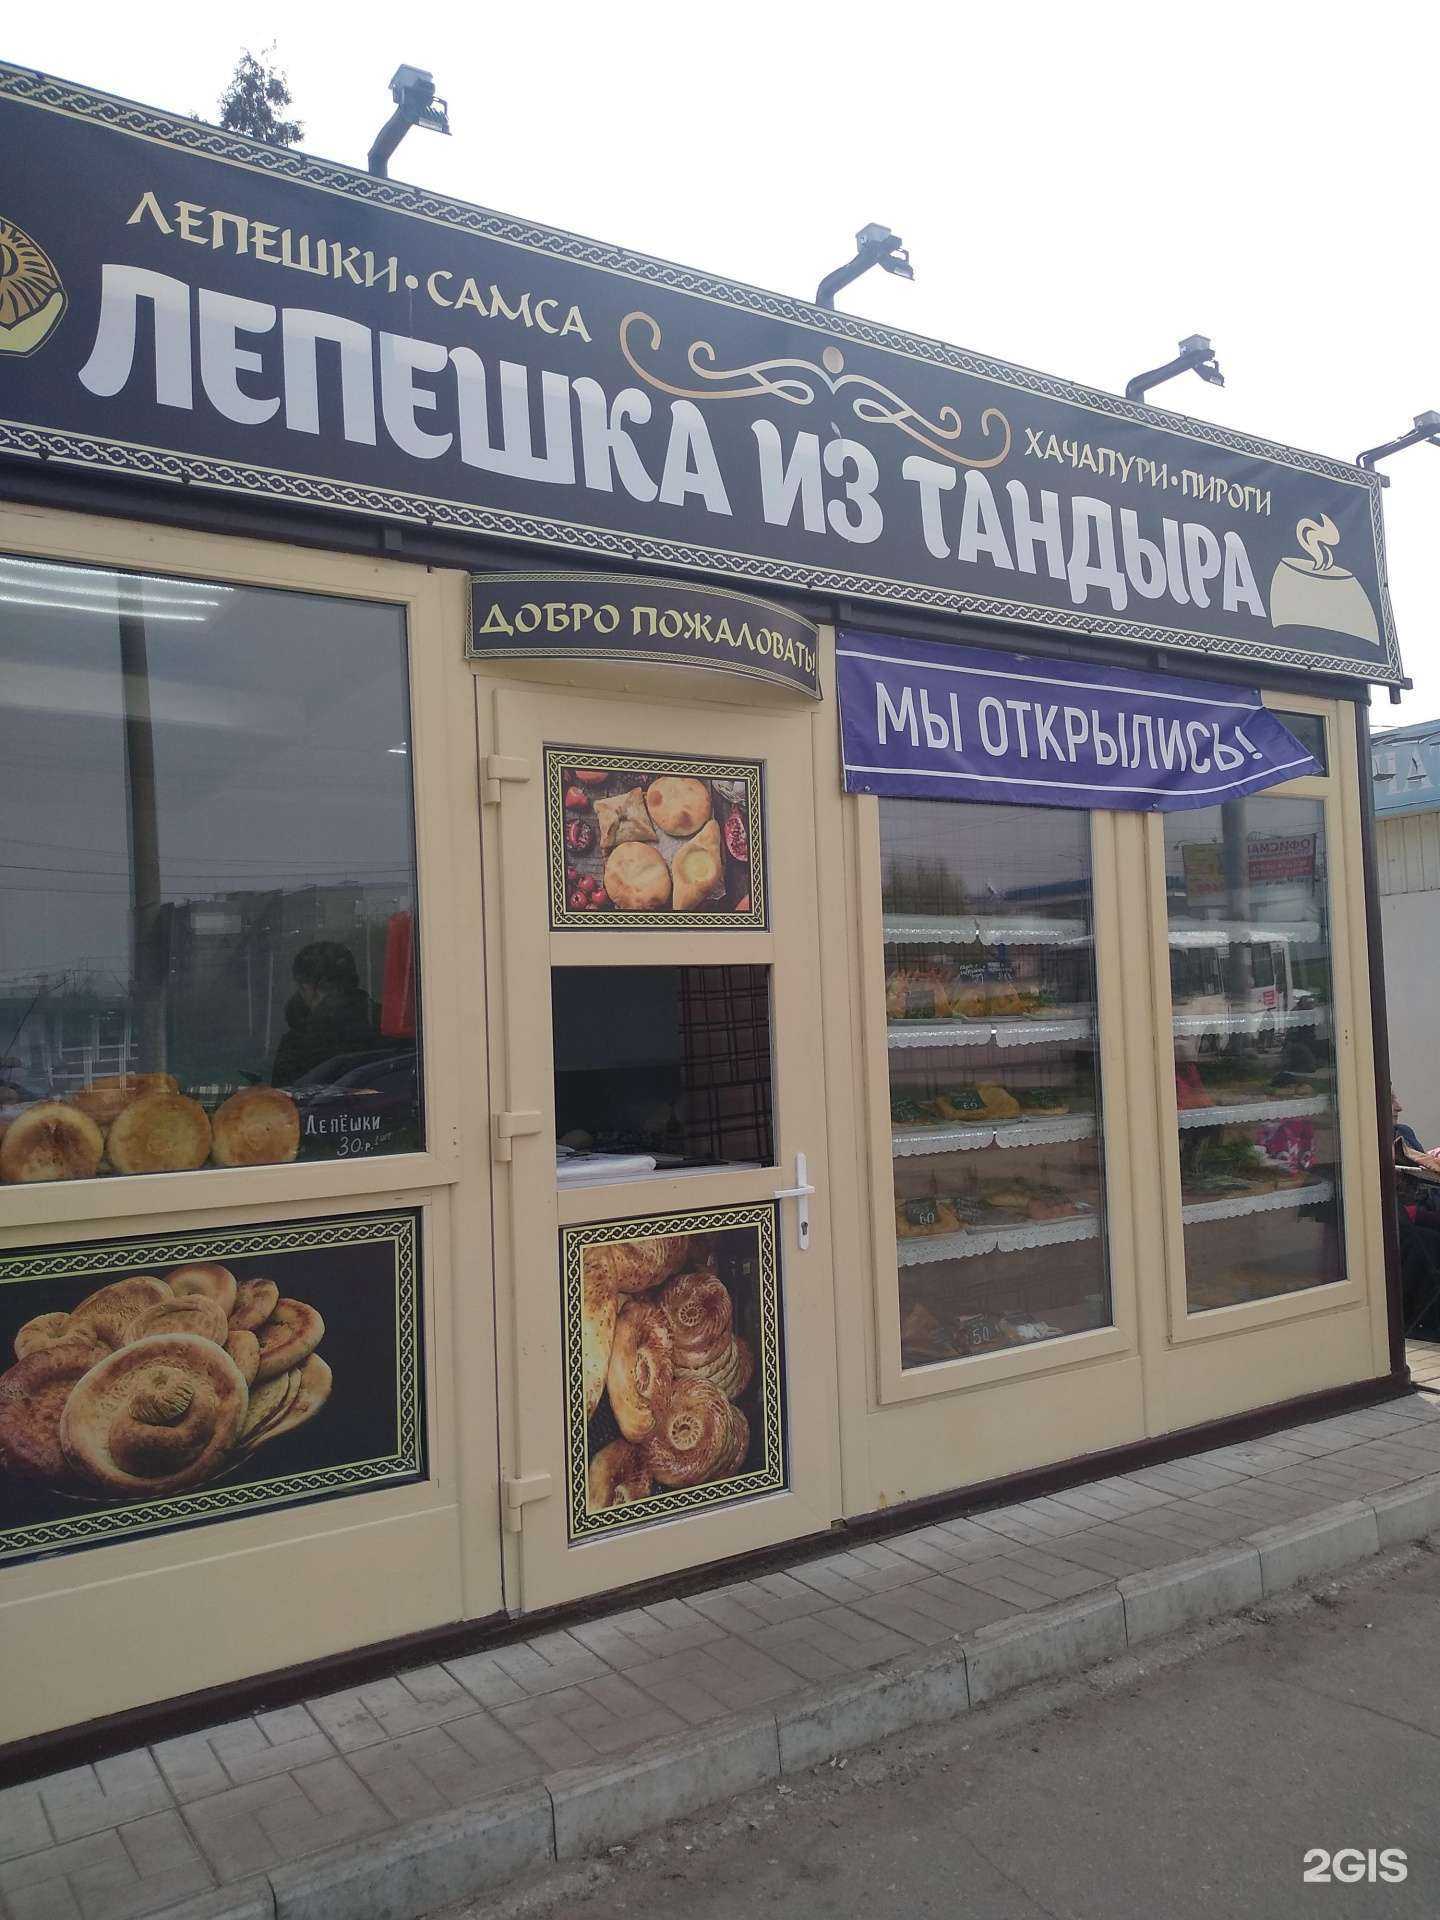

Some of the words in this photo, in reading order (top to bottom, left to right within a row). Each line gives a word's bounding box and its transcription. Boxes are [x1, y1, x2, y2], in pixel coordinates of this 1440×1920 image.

[127, 191, 398, 293] ЛЕПЕШКИ
[427, 270, 592, 343] САМСА
[78, 263, 732, 516] ЛЕПЕШКА
[752, 419, 884, 545] ИЗ
[903, 455, 1268, 619] ТАНДЫРА
[1024, 427, 1168, 491] ХАЧАПУРИ
[1181, 468, 1272, 517] ПИРОГИ
[480, 602, 621, 637] ДОБРО
[631, 605, 816, 677] ПОЖАЛОВАТЬ!
[875, 681, 963, 754] МЫ
[977, 696, 1263, 775] ОТКРЫЛИСЬ!
